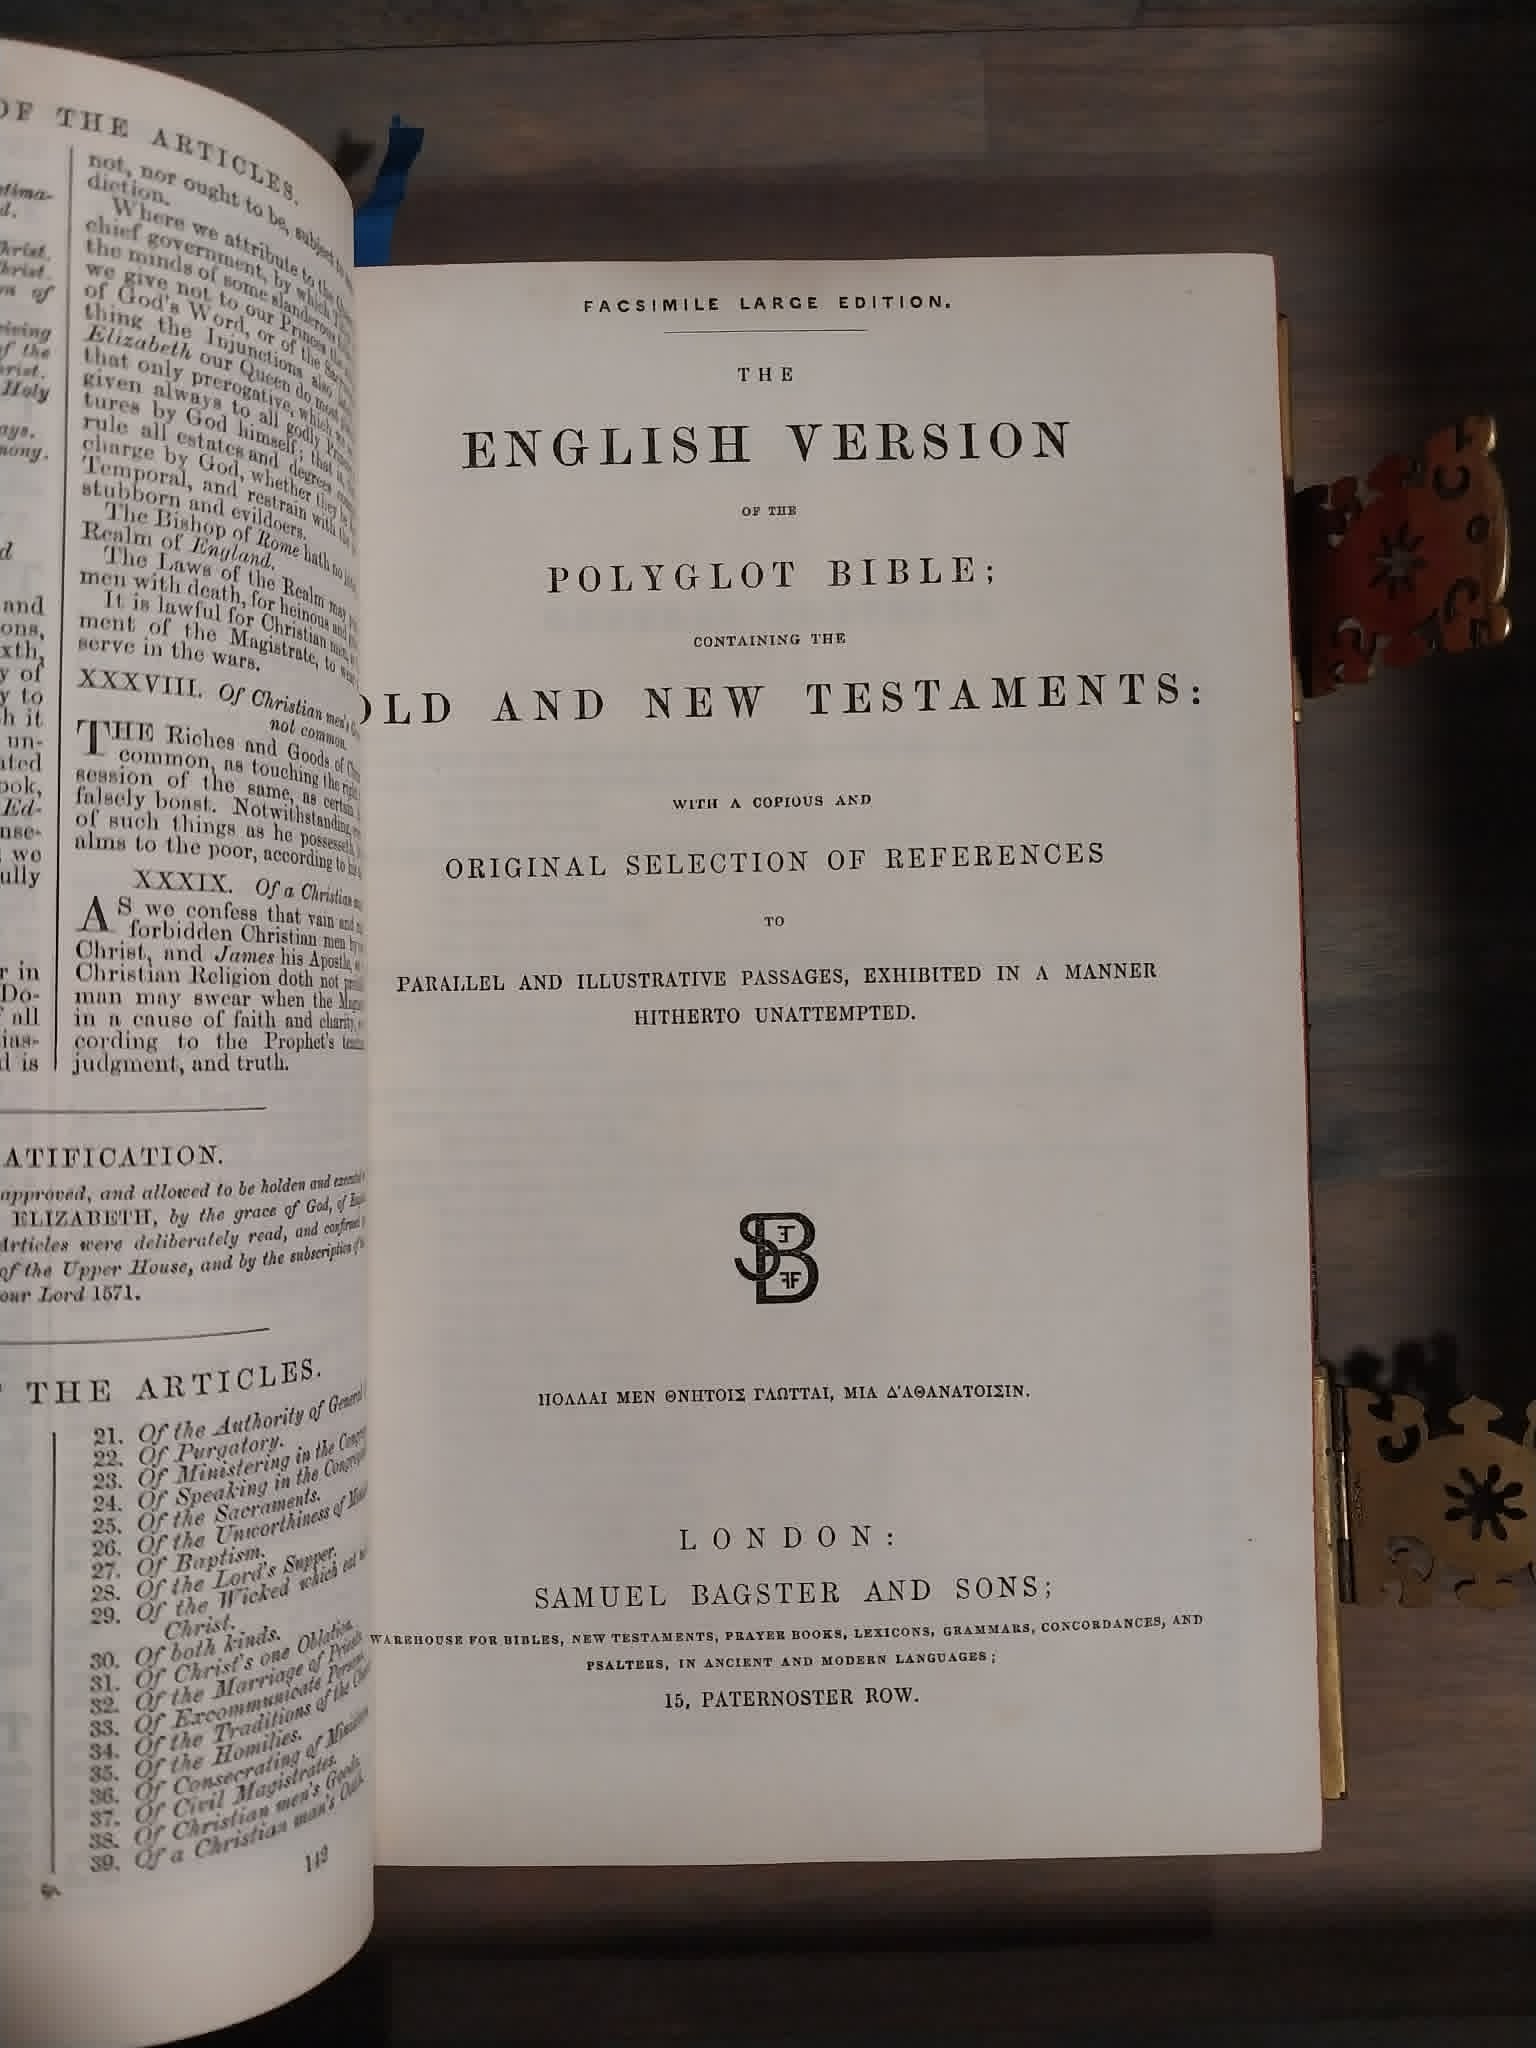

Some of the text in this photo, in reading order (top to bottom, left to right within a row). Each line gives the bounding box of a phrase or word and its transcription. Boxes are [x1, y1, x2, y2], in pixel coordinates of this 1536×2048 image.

[56, 106, 129, 138] THE
[152, 127, 299, 206] ARTICLES.
[583, 294, 951, 313] FACSIMILE LARGE EDITION.
[737, 366, 793, 384] THE
[462, 421, 1071, 470] ENGLISH VERSION
[742, 504, 797, 516] OF THE
[547, 554, 994, 594] POLYGLOT BIBLE;
[78, 636, 260, 671] serve in the wars.
[693, 631, 846, 648] CONTAINING THE
[77, 668, 203, 698] XXXVIII.
[219, 683, 246, 706] Of
[252, 689, 322, 720] Christian
[490, 688, 606, 722] AND
[645, 684, 766, 719] NEW
[807, 672, 1202, 714] TESTAMENTS:
[76, 719, 153, 756] THE
[166, 724, 234, 751] Riches
[246, 737, 277, 757] and
[288, 742, 329, 768] Goods
[672, 793, 872, 810] WITH A COPIOUS AND
[445, 840, 1105, 881] ORIGINAL SELECTION OF REFERENCES
[132, 869, 233, 894] XXXIX.
[256, 878, 280, 898] Of
[283, 886, 295, 898] a
[145, 903, 175, 918] we
[186, 901, 257, 922] confess
[267, 905, 301, 924] that
[763, 914, 785, 927] TO
[75, 940, 304, 967] Christ, and James his
[396, 962, 1158, 993] PARALLEL AND ILLUSTRATIVE PASSAGES, EXHIBITED IN A MANNER
[633, 1004, 917, 1026] HITHERTO UNATTEMPTED.
[72, 1052, 290, 1077] judgment, and truth.
[0, 1184, 92, 1206] approved,
[100, 1184, 135, 1201] and
[142, 1182, 210, 1201] allowed
[217, 1183, 232, 1197] to
[239, 1180, 255, 1196] be
[261, 1177, 305, 1194] holden
[310, 1174, 331, 1190] and
[11, 1209, 158, 1228] ELIZABETH,
[169, 1208, 189, 1229] by
[200, 1207, 225, 1222] the
[233, 1206, 277, 1224] grace
[285, 1199, 300, 1219] of
[306, 1196, 332, 1215] God,
[0, 1284, 141, 1303] our Lord 1571.
[26, 1358, 320, 1404] THE ARTICLES.
[615, 1390, 656, 1405] ΜΕΝ
[844, 1385, 878, 1400] ΜΙΑ
[92, 1400, 325, 1445] 21. Of the Authority of
[92, 1435, 284, 1468] 22. Of Purgatory.
[92, 1489, 321, 1535] 25. Of the Sacraments.
[679, 1523, 897, 1552] LONDON:
[535, 1574, 1054, 1610] SAMUEL BAGSTER AND SONS;
[370, 1614, 1204, 1647] WAREHOUSE FOR BIBLES, NEW TESTAMENTS, PRAYER BOOKS, LEXICONS, GRAMMARS, CONCORDANCES, AND
[586, 1659, 670, 1671] PSALTERS,
[679, 1658, 696, 1669] IN
[704, 1657, 773, 1668] ANCIENT
[781, 1656, 814, 1667] AND
[822, 1655, 888, 1666] MODERN
[664, 1687, 920, 1711] 15, PATERNOSTER ROW.
